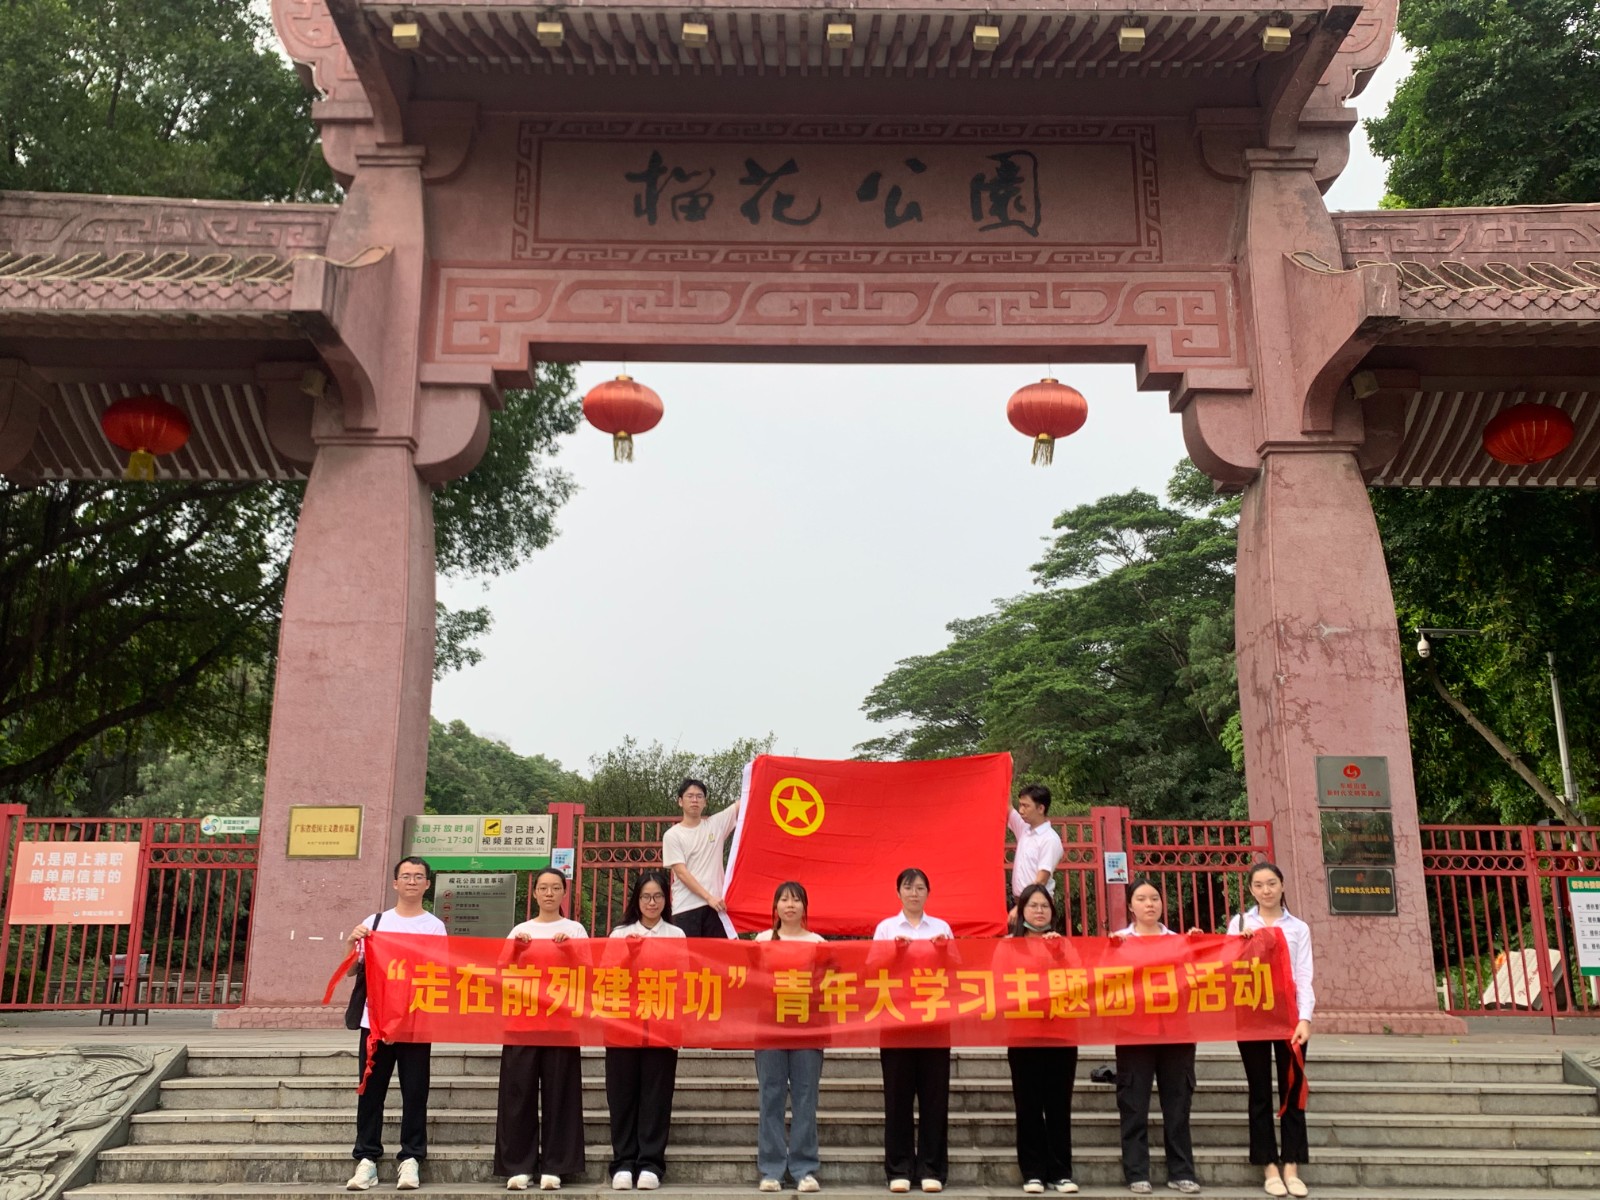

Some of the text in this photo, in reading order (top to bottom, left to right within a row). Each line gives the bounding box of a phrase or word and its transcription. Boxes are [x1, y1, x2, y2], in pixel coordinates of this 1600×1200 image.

[504, 825, 545, 834] 您已进入
[482, 837, 545, 845] 视频监控区域
[32, 852, 123, 866] 凡是网上兼职
[30, 870, 121, 883] 刷单刷信誉的
